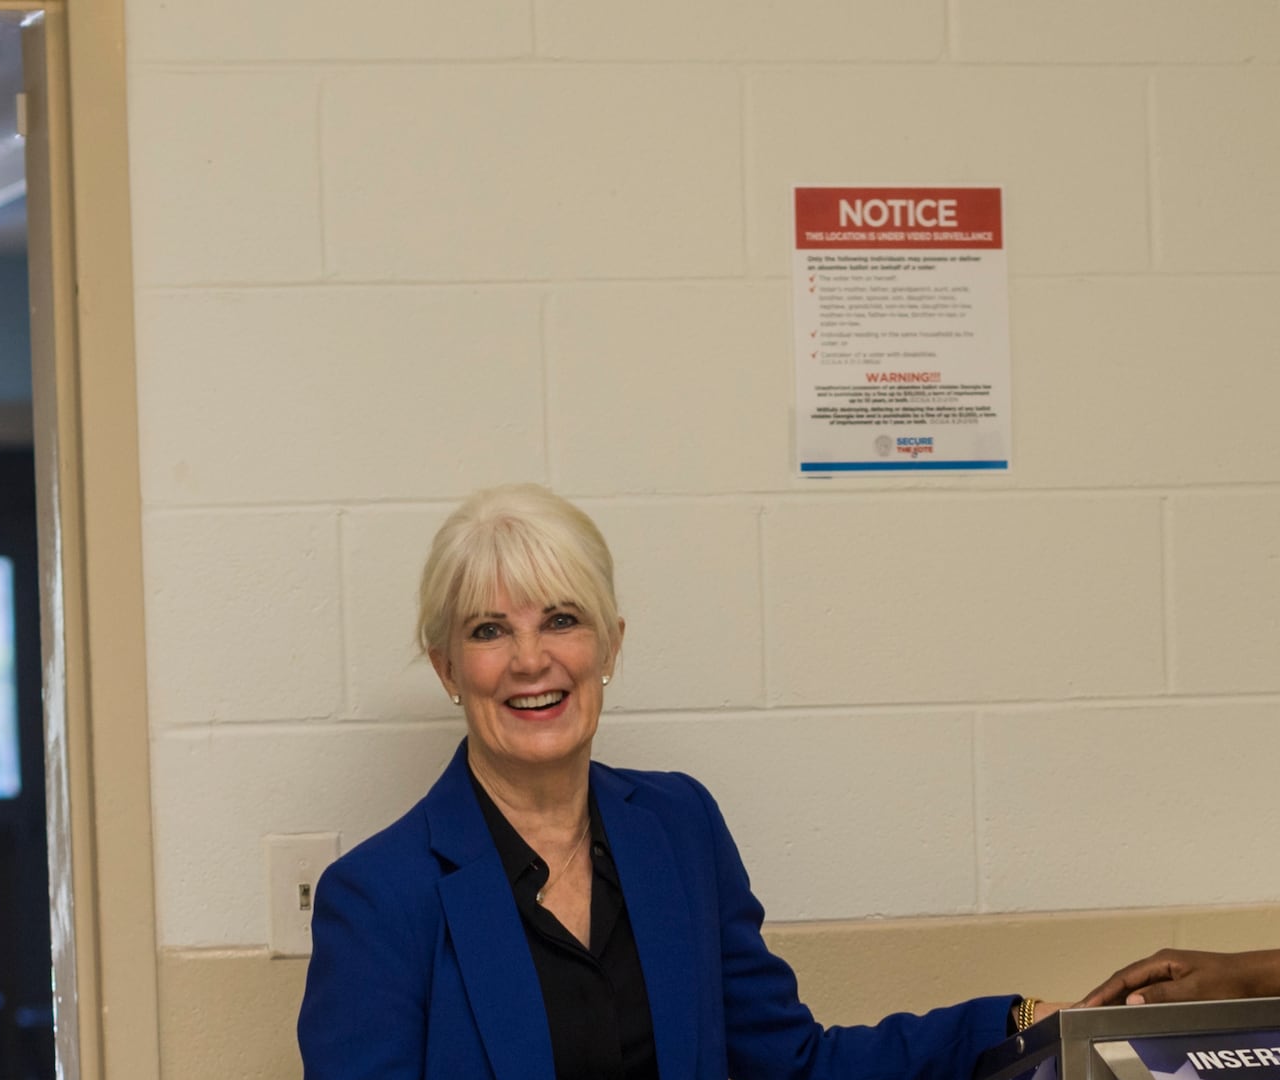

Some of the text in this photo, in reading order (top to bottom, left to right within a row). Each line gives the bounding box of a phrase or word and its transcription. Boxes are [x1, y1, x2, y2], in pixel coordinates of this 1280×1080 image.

[839, 199, 957, 227] NOTICE
[806, 231, 992, 241] THIS LOCATION IS UNDER VIDEO SURVEILLANCE
[896, 437, 933, 445] SECURE
